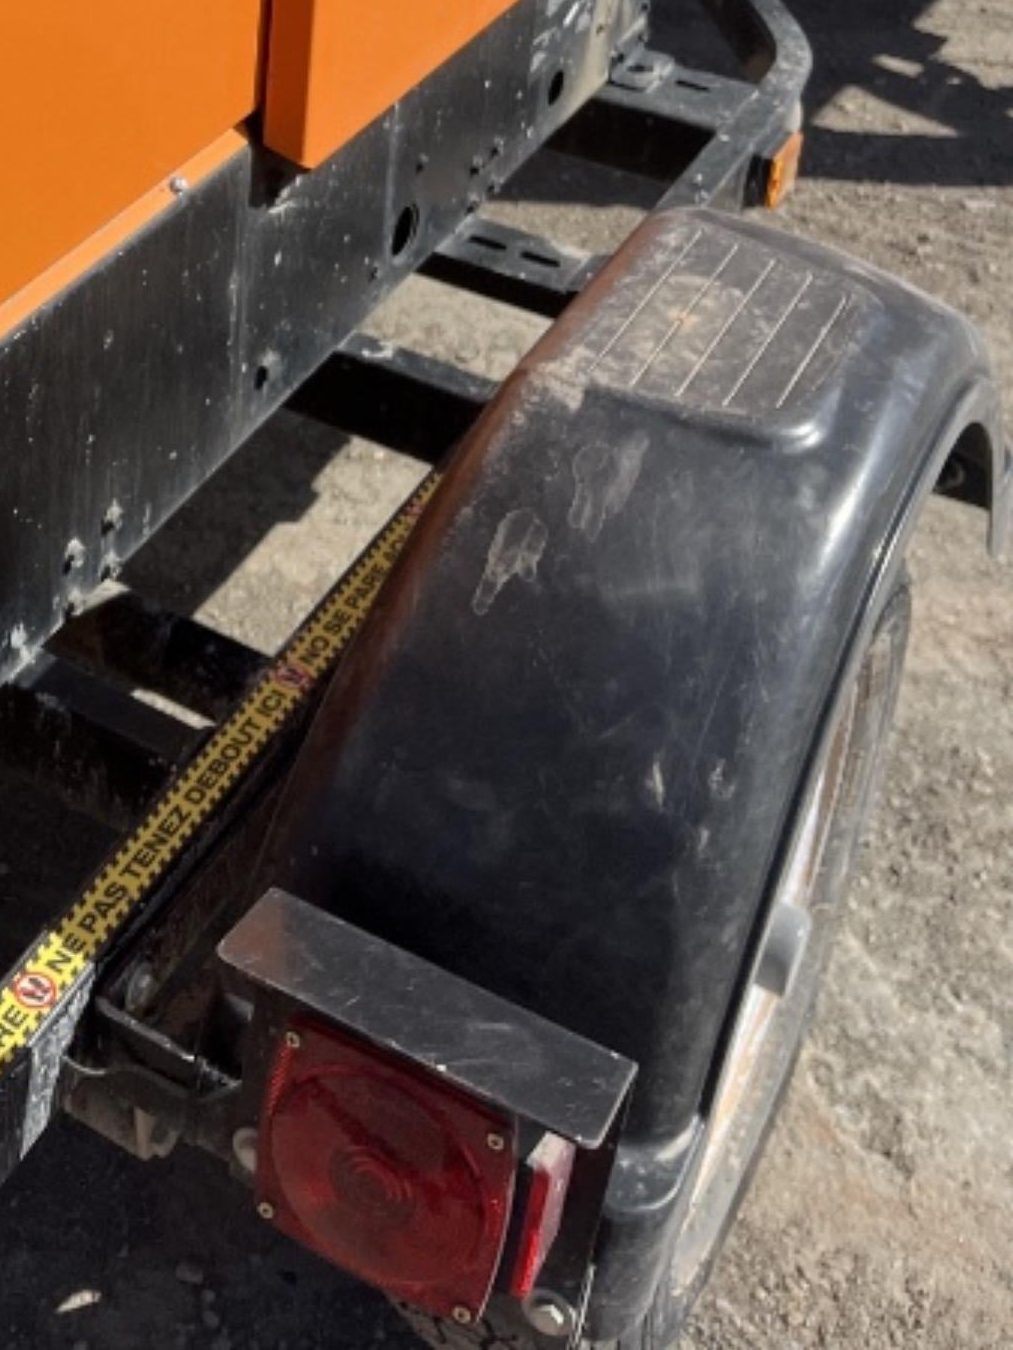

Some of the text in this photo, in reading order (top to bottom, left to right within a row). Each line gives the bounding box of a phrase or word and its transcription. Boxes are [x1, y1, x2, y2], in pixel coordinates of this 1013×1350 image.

[297, 635, 330, 667] NO
[322, 608, 354, 636] SE
[46, 690, 288, 975] NE PAS TENEZ DEBOUT ICI
